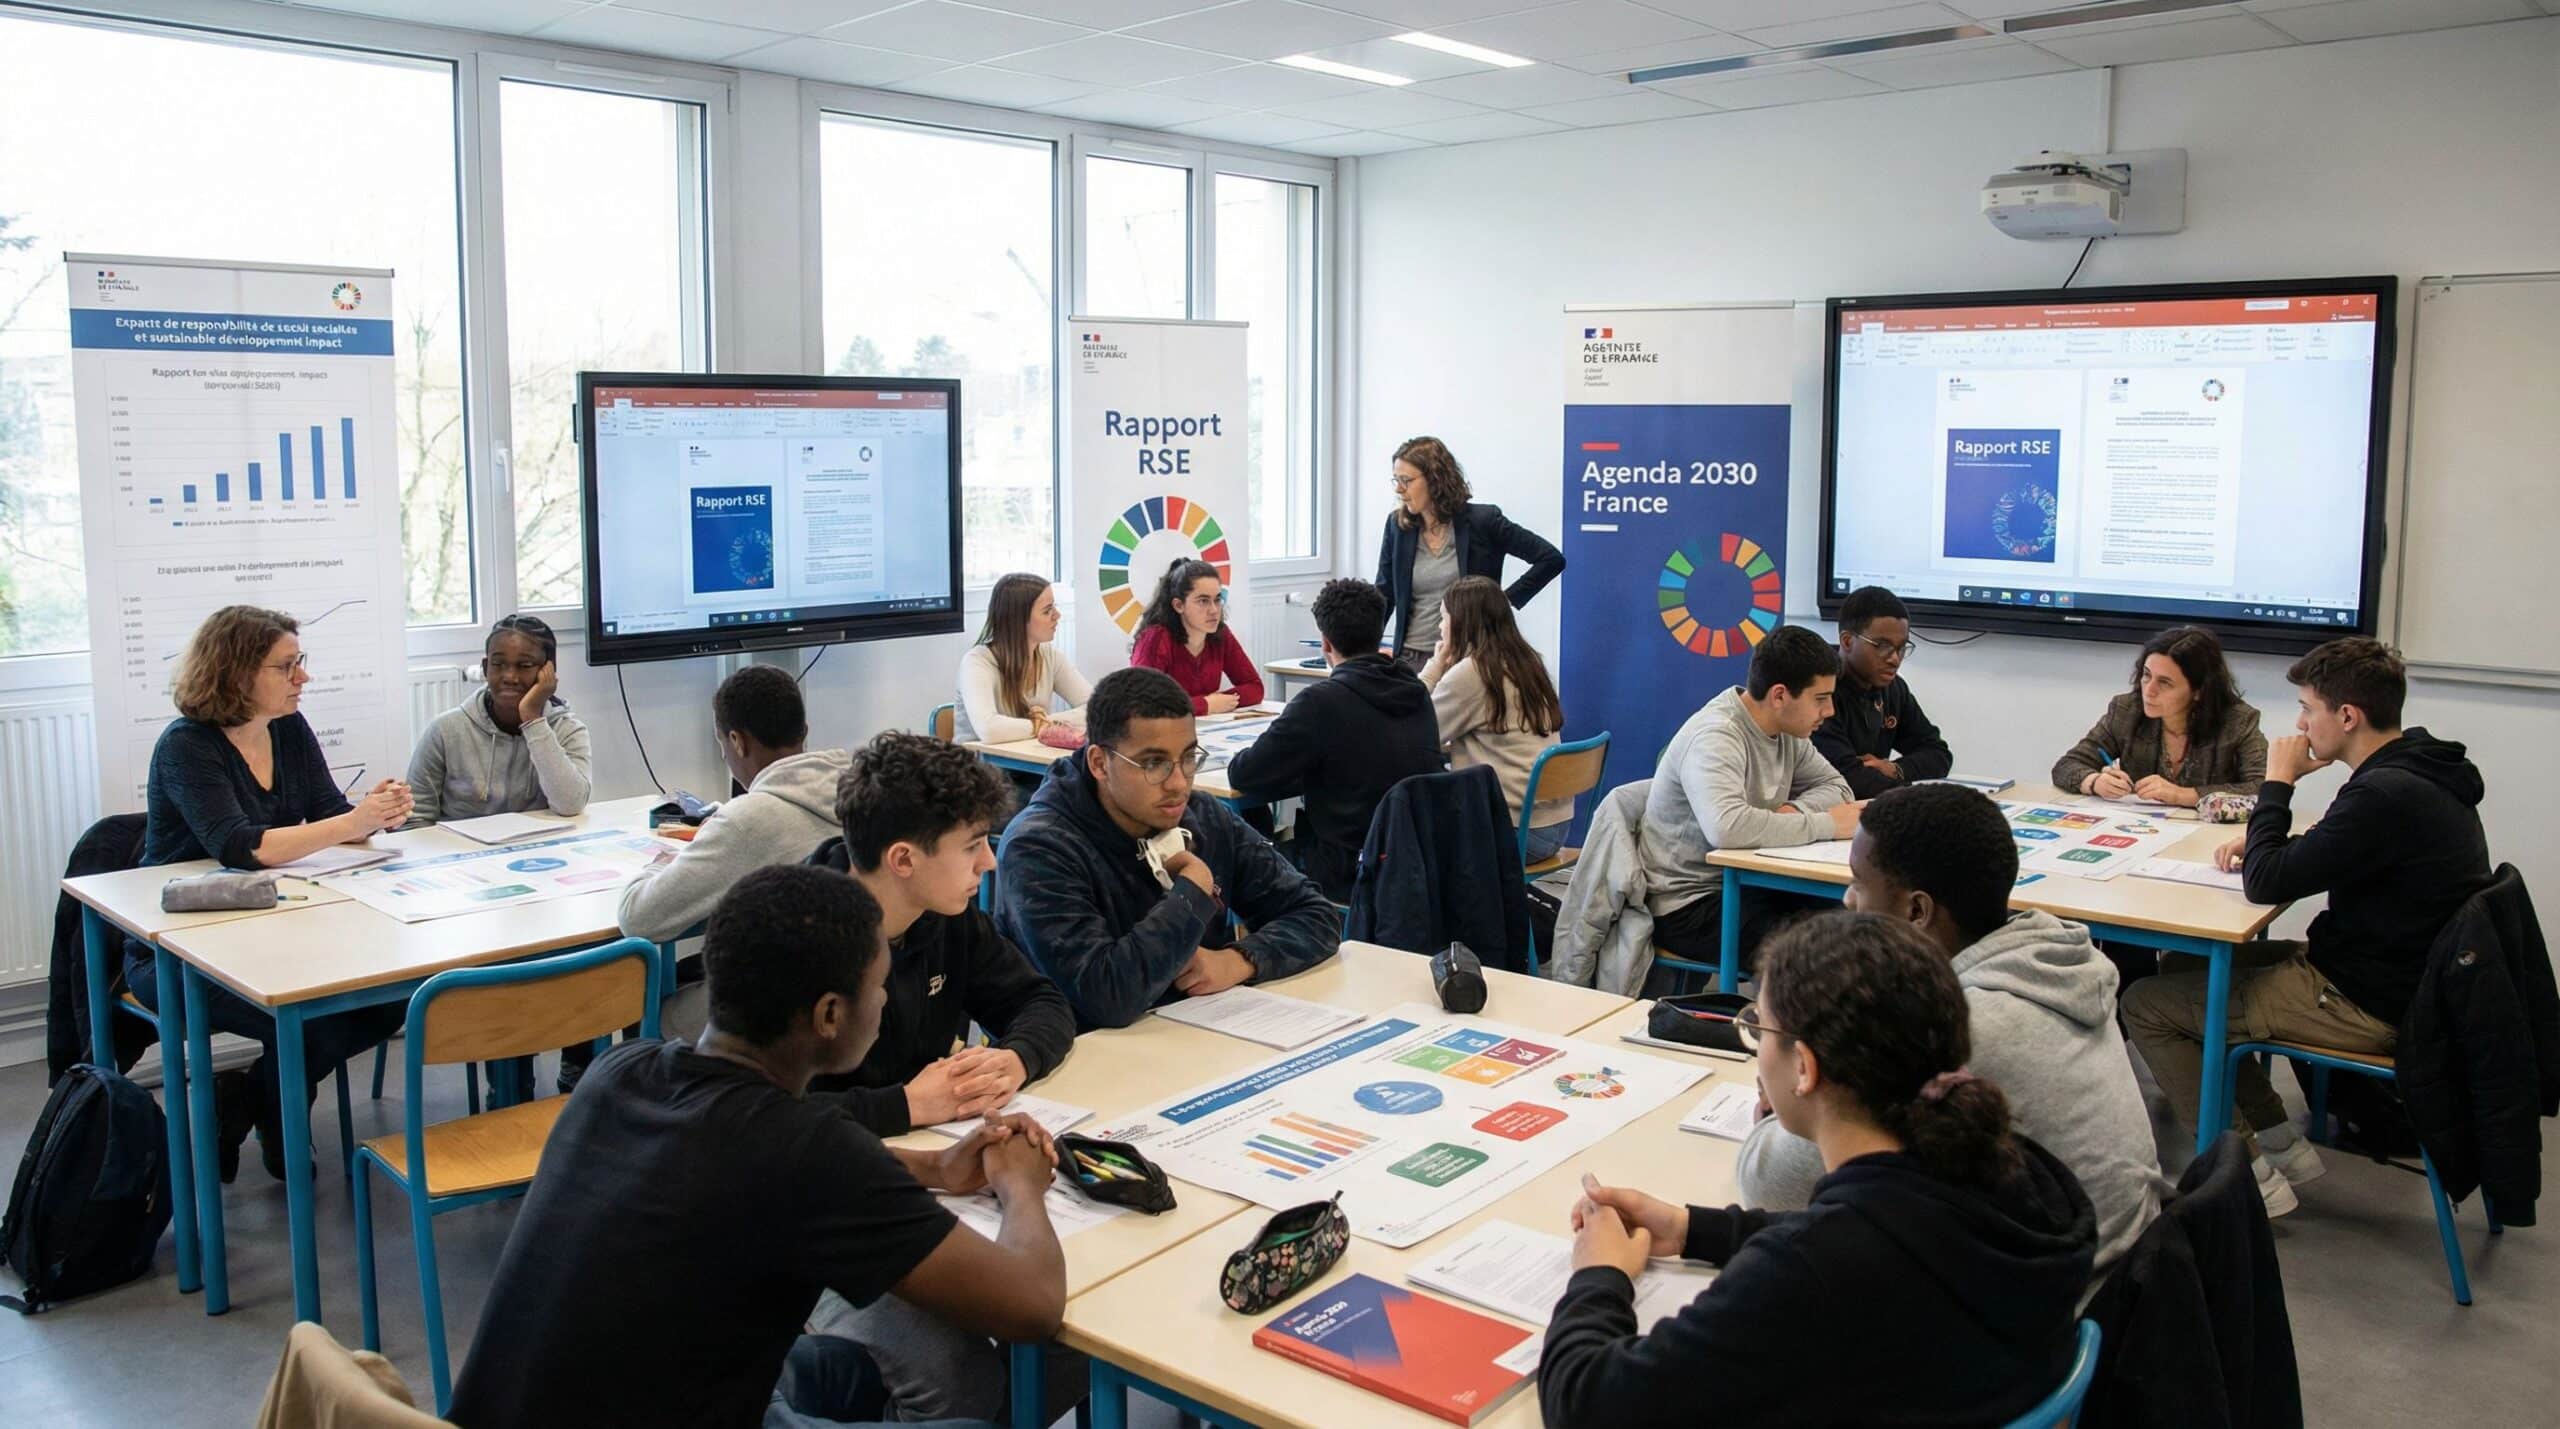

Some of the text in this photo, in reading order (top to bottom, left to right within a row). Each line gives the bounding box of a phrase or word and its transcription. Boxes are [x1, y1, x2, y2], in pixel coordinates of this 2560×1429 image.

[163, 318, 179, 329] de
[134, 333, 148, 343] et
[305, 335, 343, 350] impact
[1583, 353, 1599, 364] DE
[1105, 410, 1222, 445] Rapport
[1954, 439, 2052, 458] Rapport RSE
[1138, 448, 1191, 475] RSE
[1581, 459, 1758, 490] Agenda 2030
[696, 493, 766, 511] Rapport RSE
[1583, 489, 1669, 514] France
